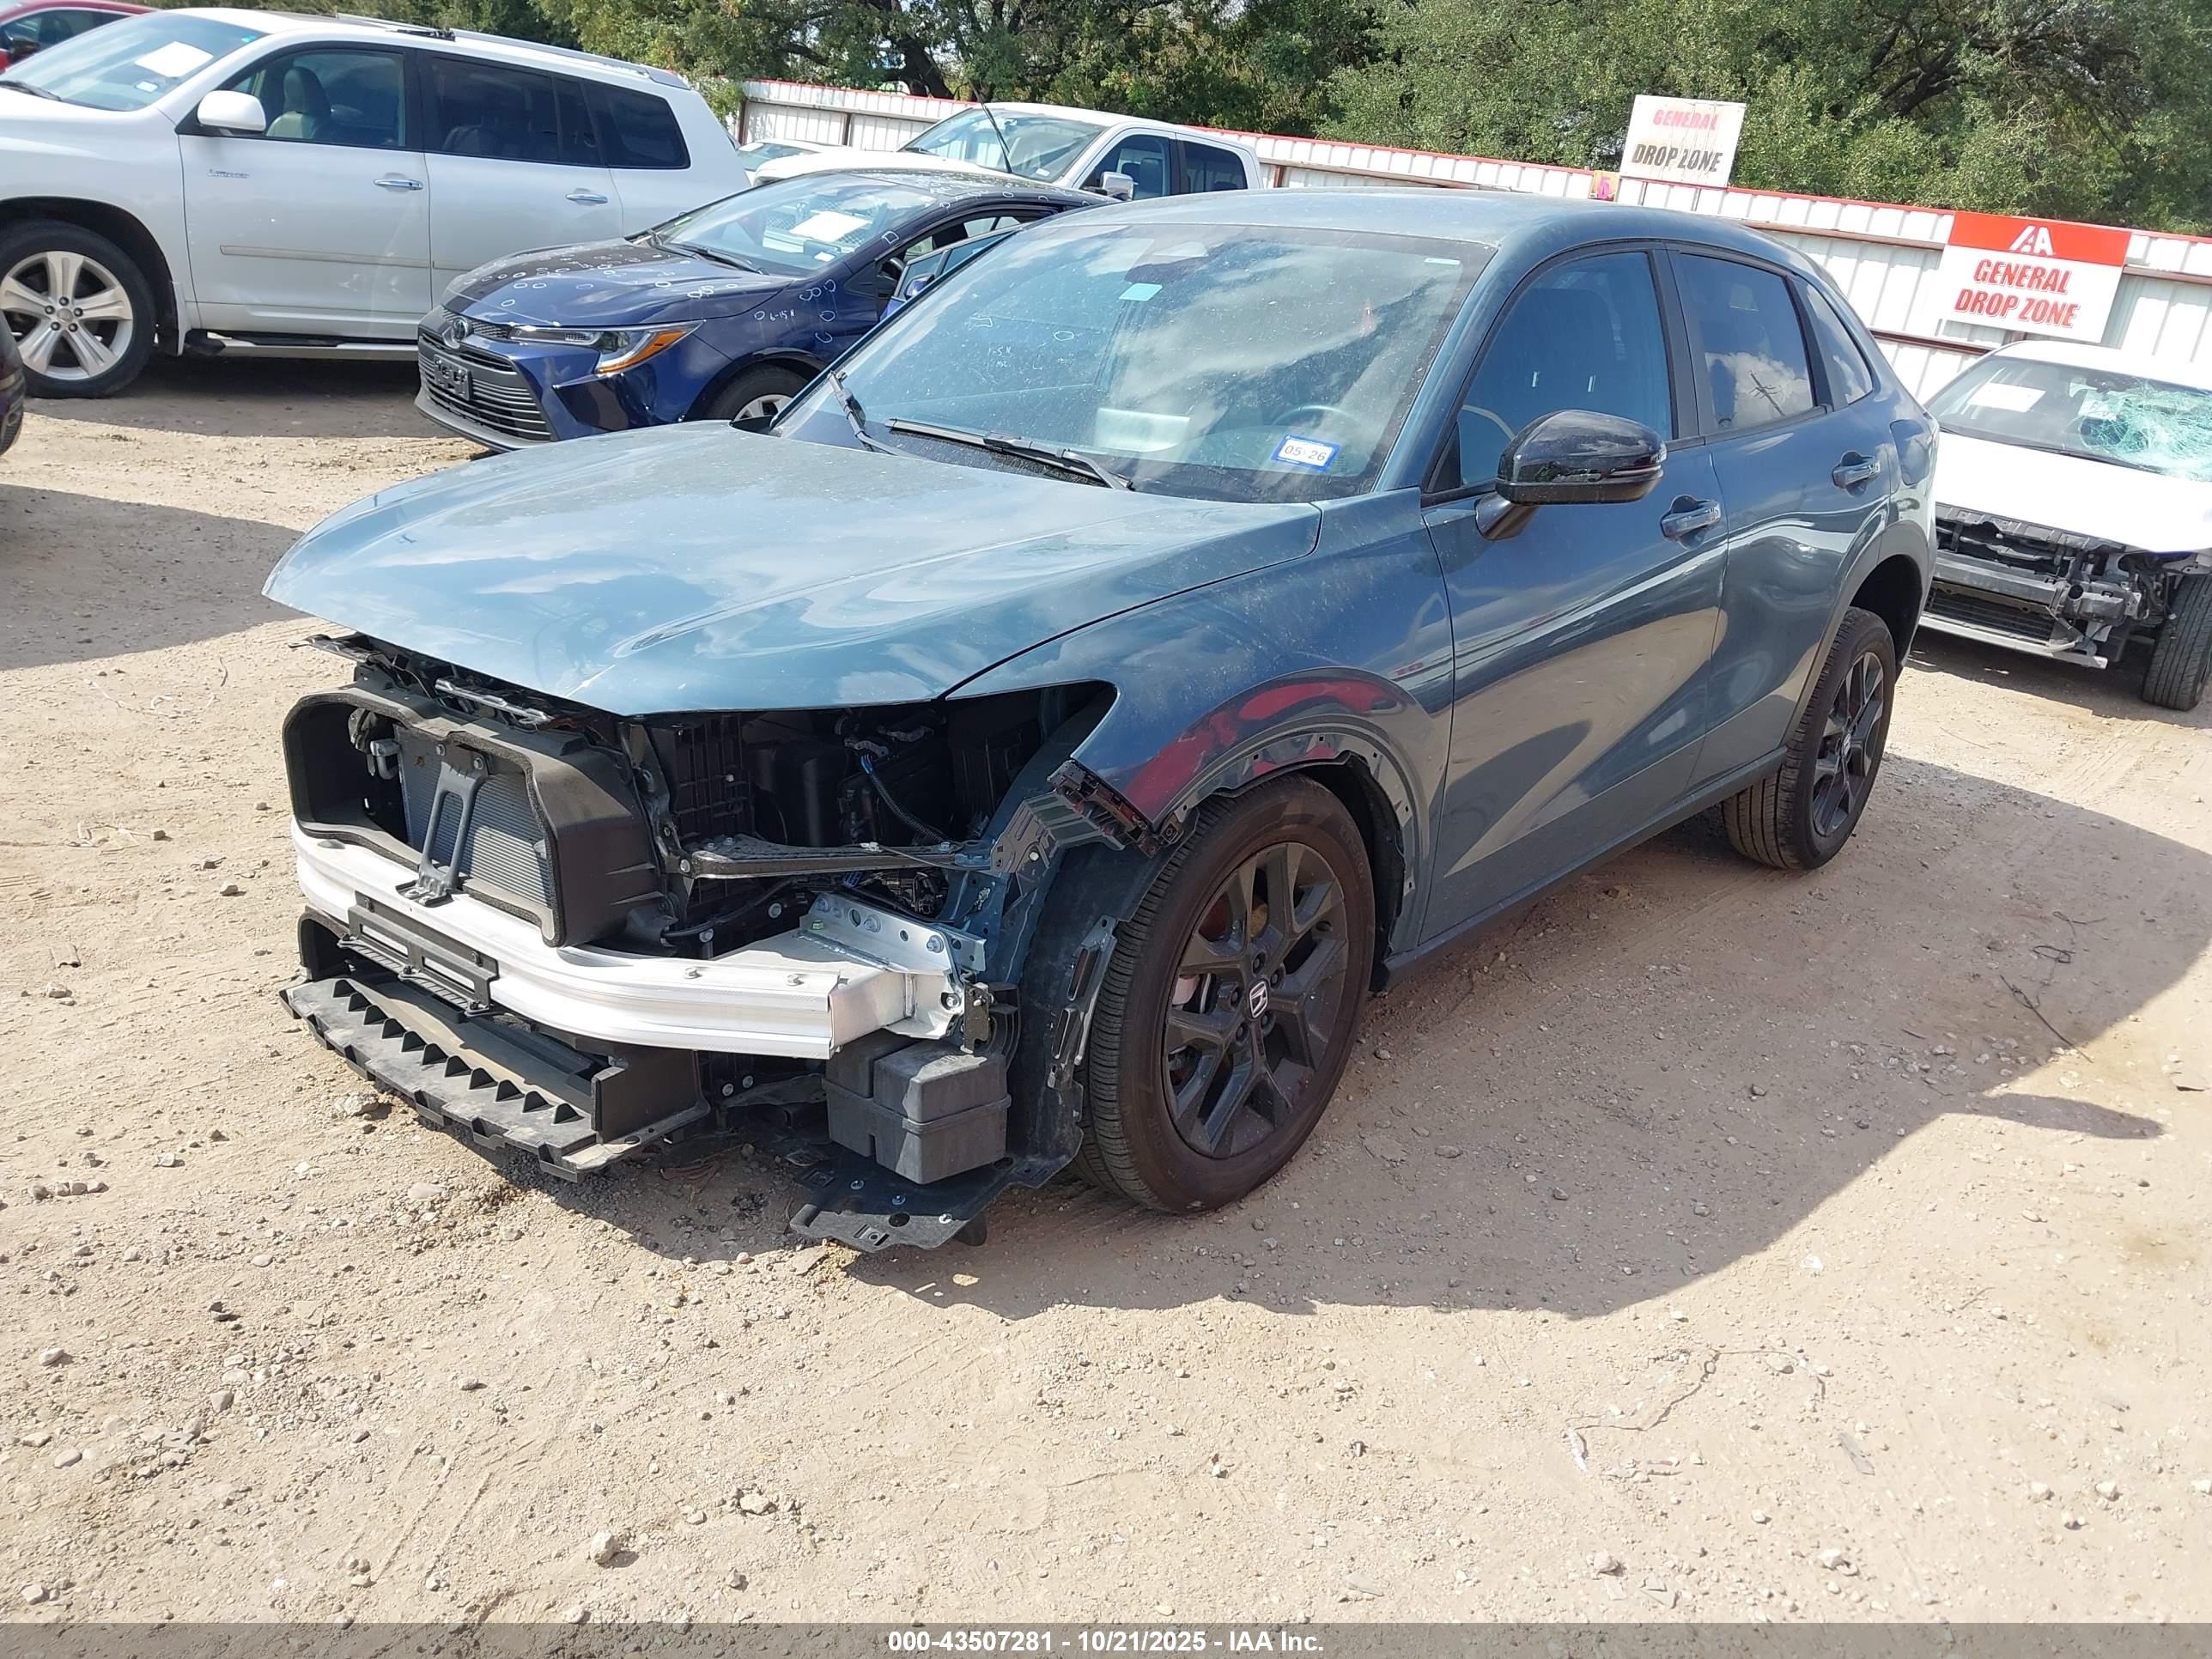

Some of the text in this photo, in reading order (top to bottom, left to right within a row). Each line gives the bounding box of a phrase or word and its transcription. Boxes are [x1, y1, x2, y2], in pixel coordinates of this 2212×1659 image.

[1653, 109, 1719, 131] GENERAL
[1632, 143, 1723, 173] DROP ZONE
[1973, 258, 2073, 295] GENERAL
[1954, 288, 2080, 328] DROP ZONE
